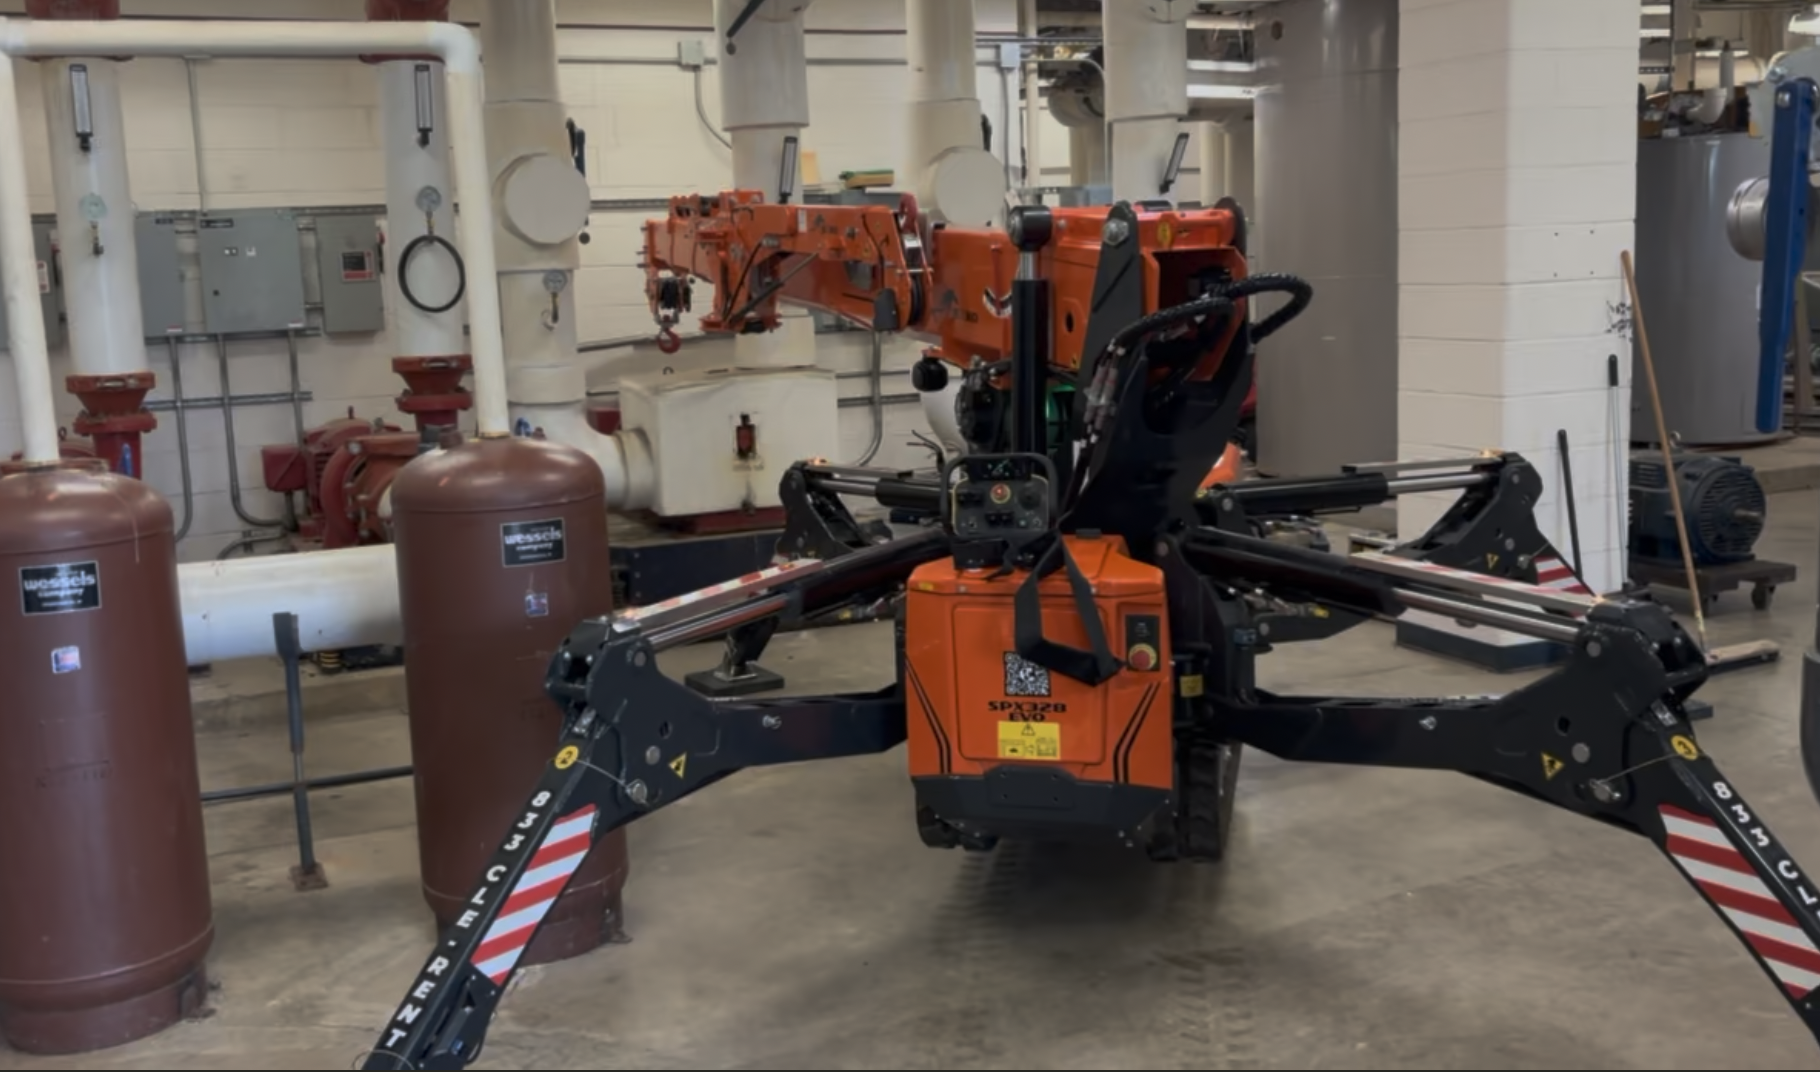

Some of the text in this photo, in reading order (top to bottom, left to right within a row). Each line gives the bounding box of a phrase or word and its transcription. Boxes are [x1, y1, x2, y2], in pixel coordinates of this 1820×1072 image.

[988, 701, 1067, 713] SPX328
[1008, 712, 1046, 722] EVO
[502, 790, 552, 851] 833
[1712, 781, 1820, 920] 833 CL
